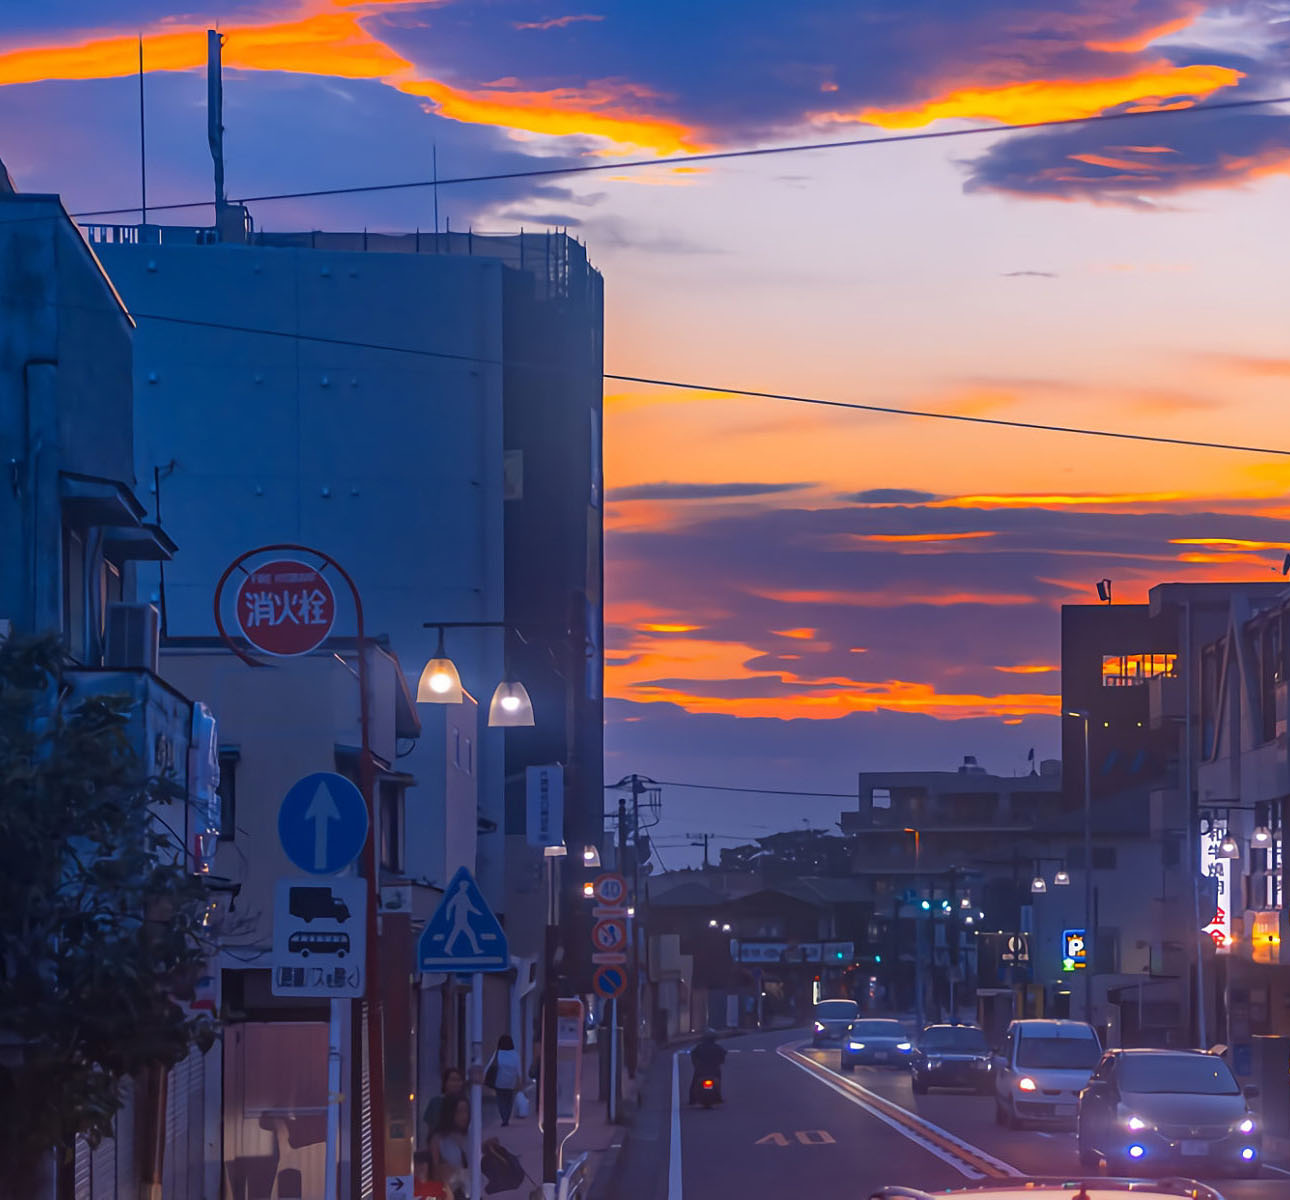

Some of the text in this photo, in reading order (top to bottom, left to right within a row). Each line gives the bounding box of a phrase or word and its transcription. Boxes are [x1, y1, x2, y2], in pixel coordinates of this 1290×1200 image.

[245, 589, 328, 627] 消火栓
[1068, 939, 1084, 956] P
